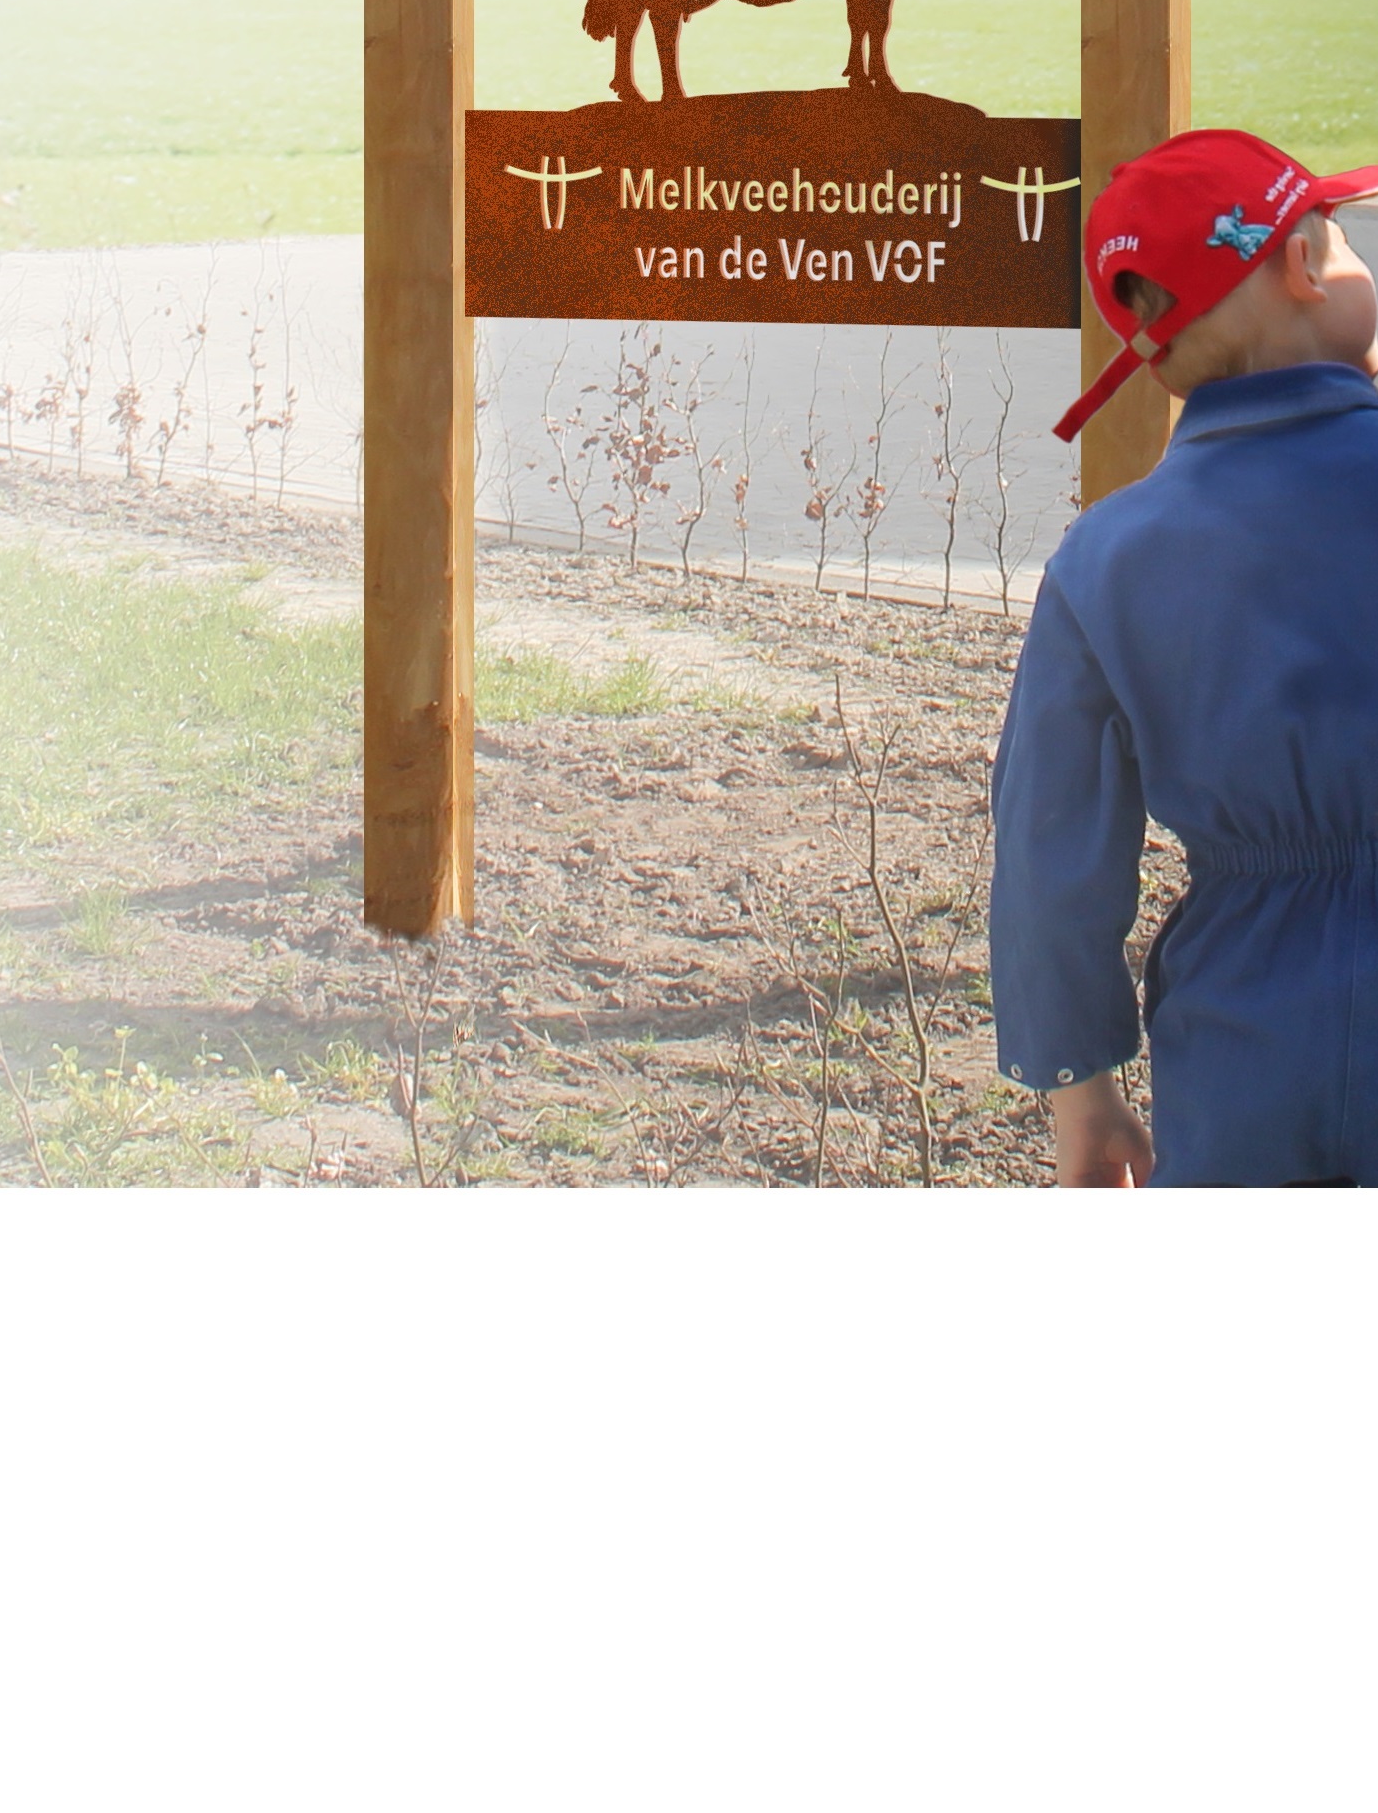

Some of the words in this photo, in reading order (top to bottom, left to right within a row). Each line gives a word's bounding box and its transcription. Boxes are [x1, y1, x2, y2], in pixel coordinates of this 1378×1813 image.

[620, 166, 962, 229] Melkveehouderij
[634, 247, 705, 279] van
[719, 234, 768, 281] de
[778, 238, 854, 282] Ven
[864, 239, 947, 284] VOF
